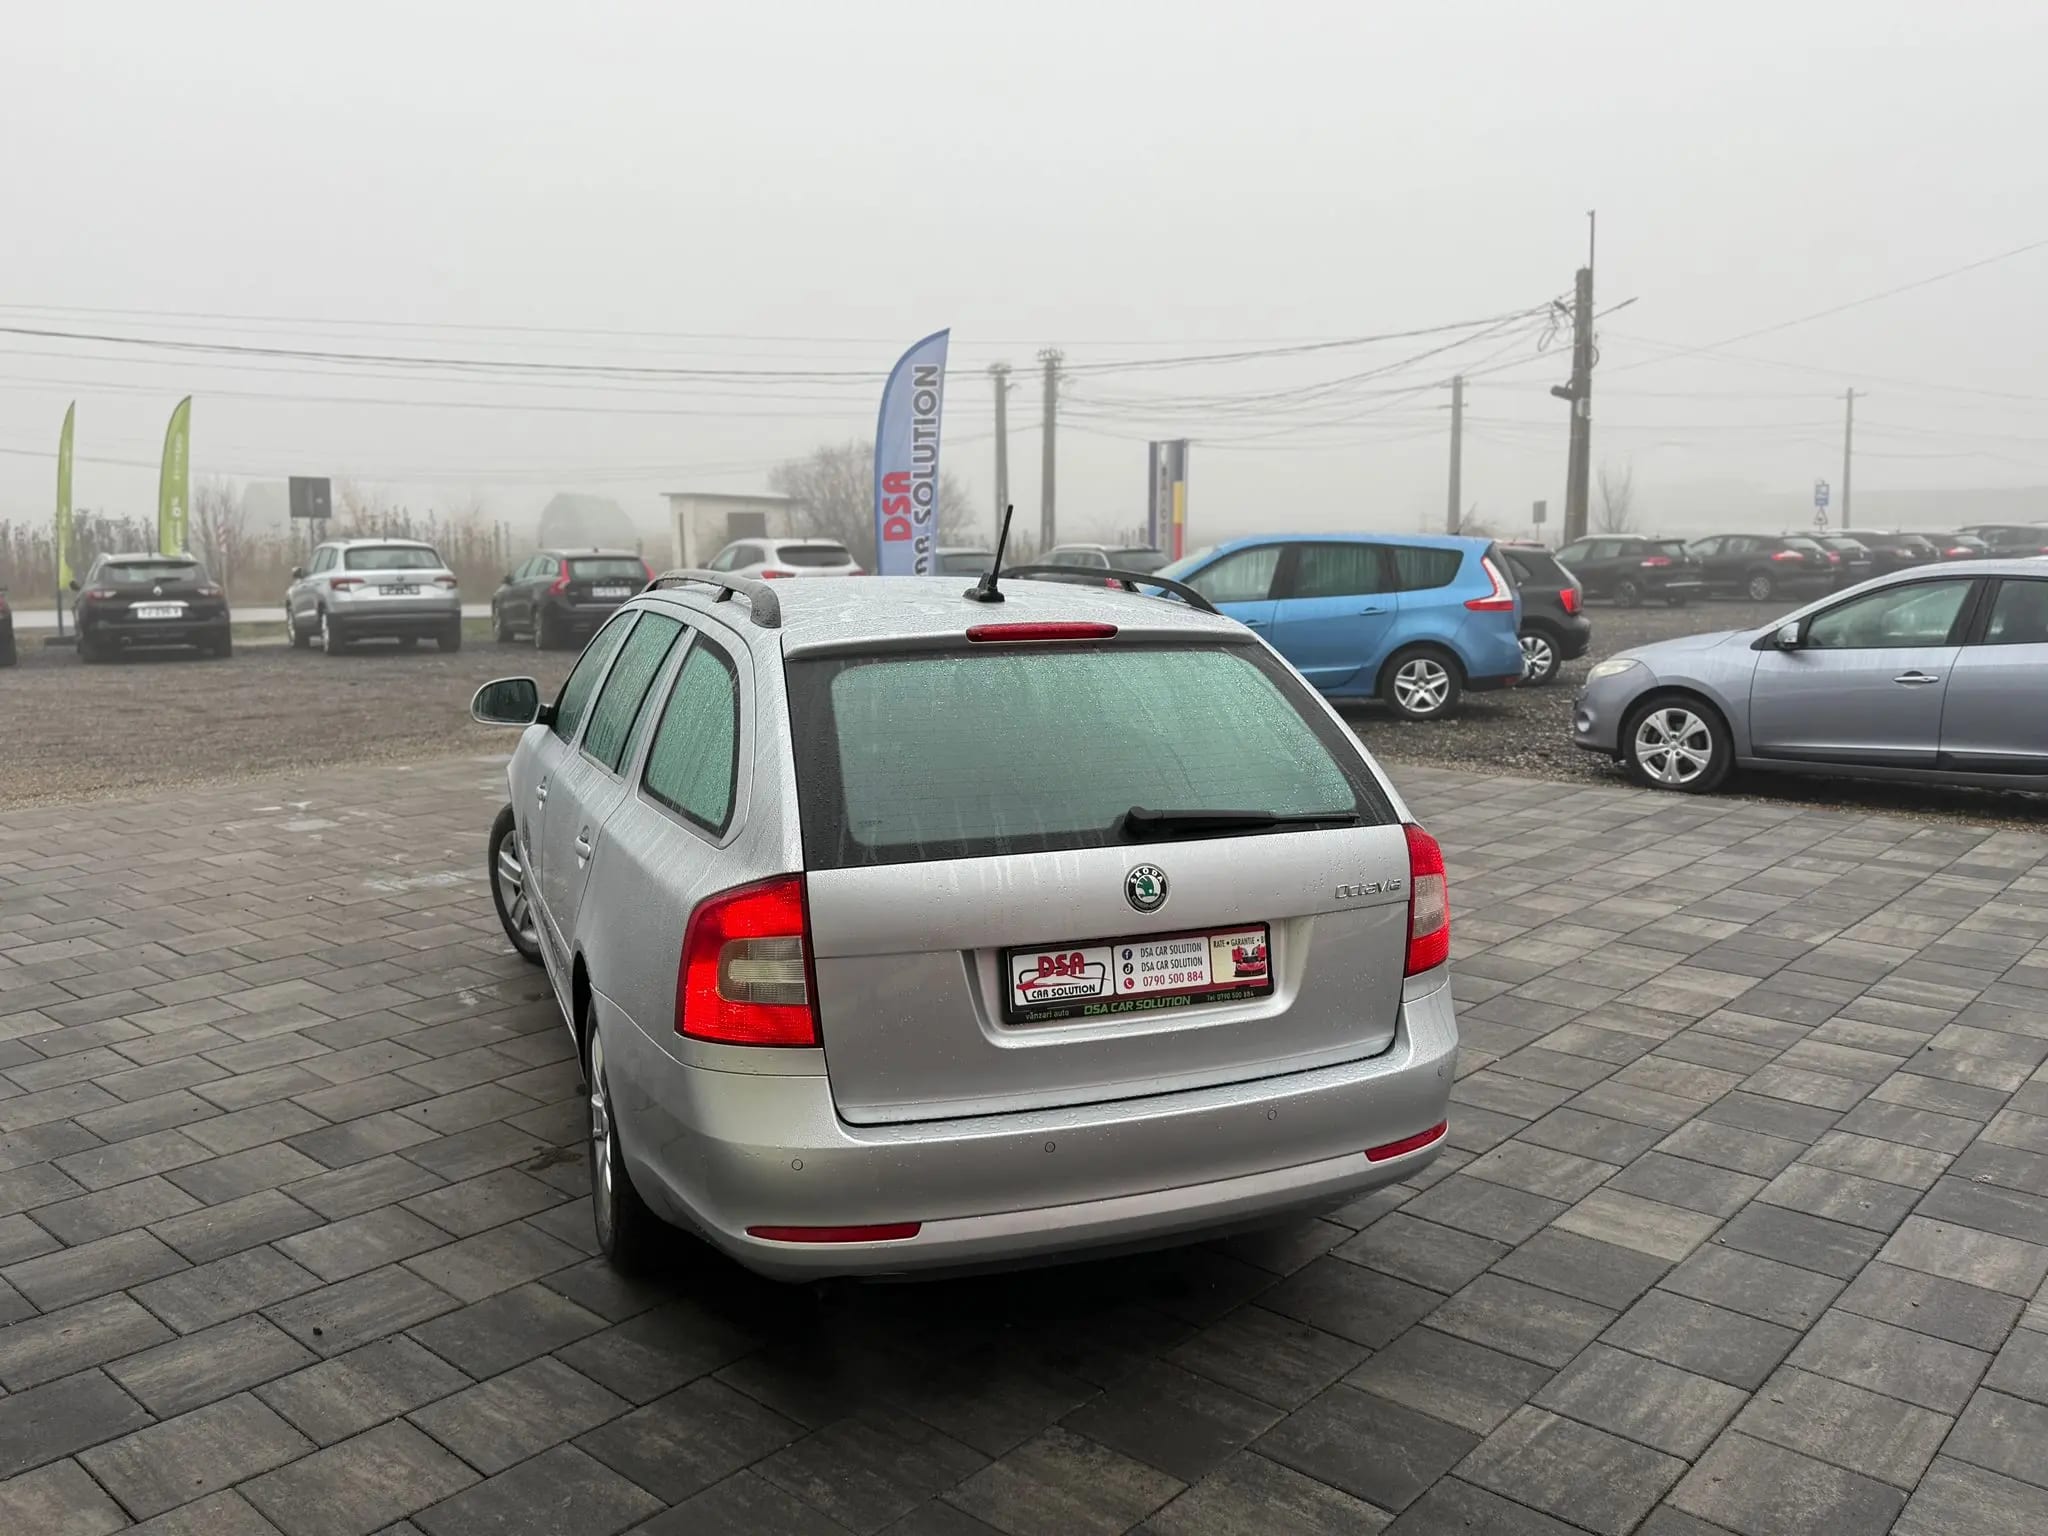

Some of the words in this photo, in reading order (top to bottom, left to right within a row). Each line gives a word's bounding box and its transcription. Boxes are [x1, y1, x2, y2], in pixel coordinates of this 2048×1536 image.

[912, 366, 938, 525] SOLUTION
[882, 471, 912, 542] DSA
[914, 535, 931, 576] AR
[1140, 947, 1154, 958] DSA
[1155, 946, 1168, 957] CAR
[1169, 942, 1202, 955] SOLUTION
[1213, 940, 1226, 948] RATE
[1038, 952, 1085, 978] DSA
[1141, 962, 1155, 972] DSA
[1156, 960, 1169, 970] CAR
[1170, 956, 1203, 969] SOLUTION
[1143, 974, 1165, 987] 0790
[1168, 972, 1184, 984] 500
[1186, 971, 1204, 982] 884
[1031, 989, 1049, 999] CAR
[1051, 984, 1096, 997] SOLUTION
[1053, 1009, 1070, 1017] auto
[1084, 1004, 1109, 1015] DSA
[1110, 1000, 1134, 1013] CAR
[1135, 995, 1191, 1010] SOLUTION
